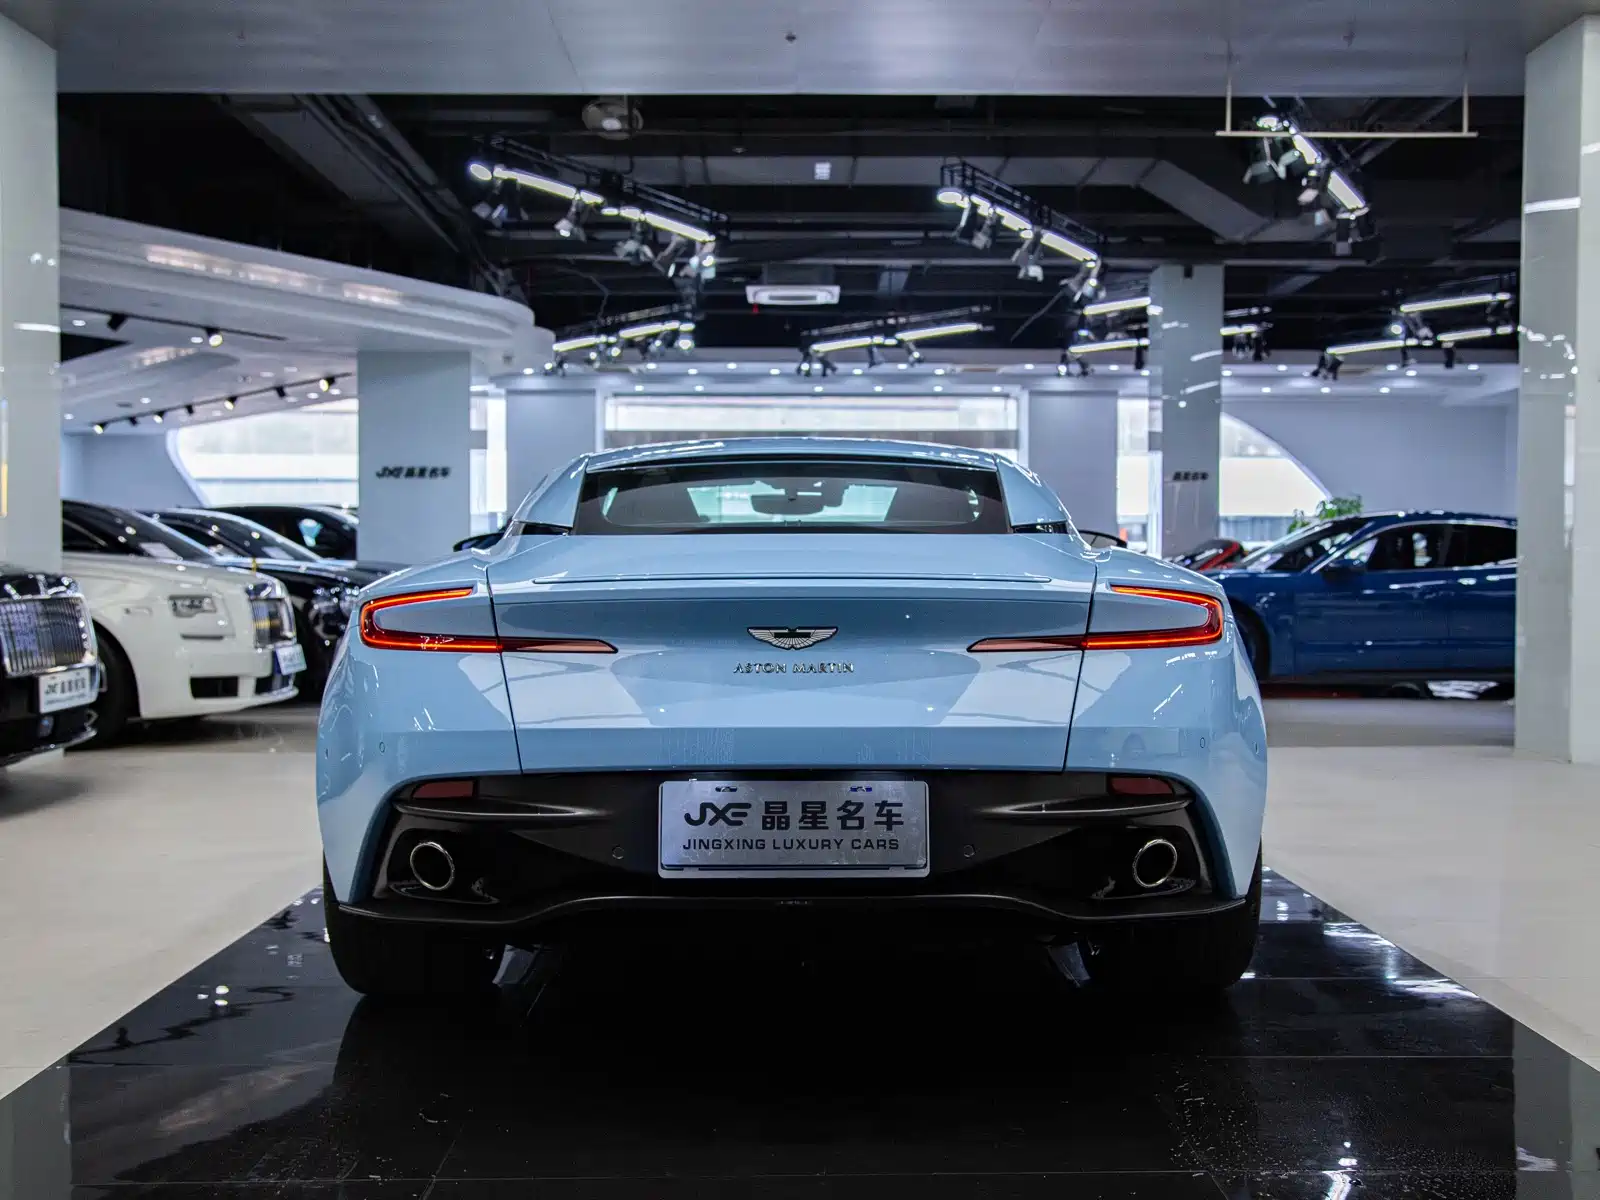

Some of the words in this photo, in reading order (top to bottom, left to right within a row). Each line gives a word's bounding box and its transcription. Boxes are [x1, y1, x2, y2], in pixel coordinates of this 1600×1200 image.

[733, 662, 787, 674] ASTON
[792, 662, 854, 674] MARTIN
[761, 800, 904, 831] 晶星名车
[683, 838, 766, 850] JINGXING
[772, 838, 844, 850] LUXURY
[851, 838, 900, 850] CARS
